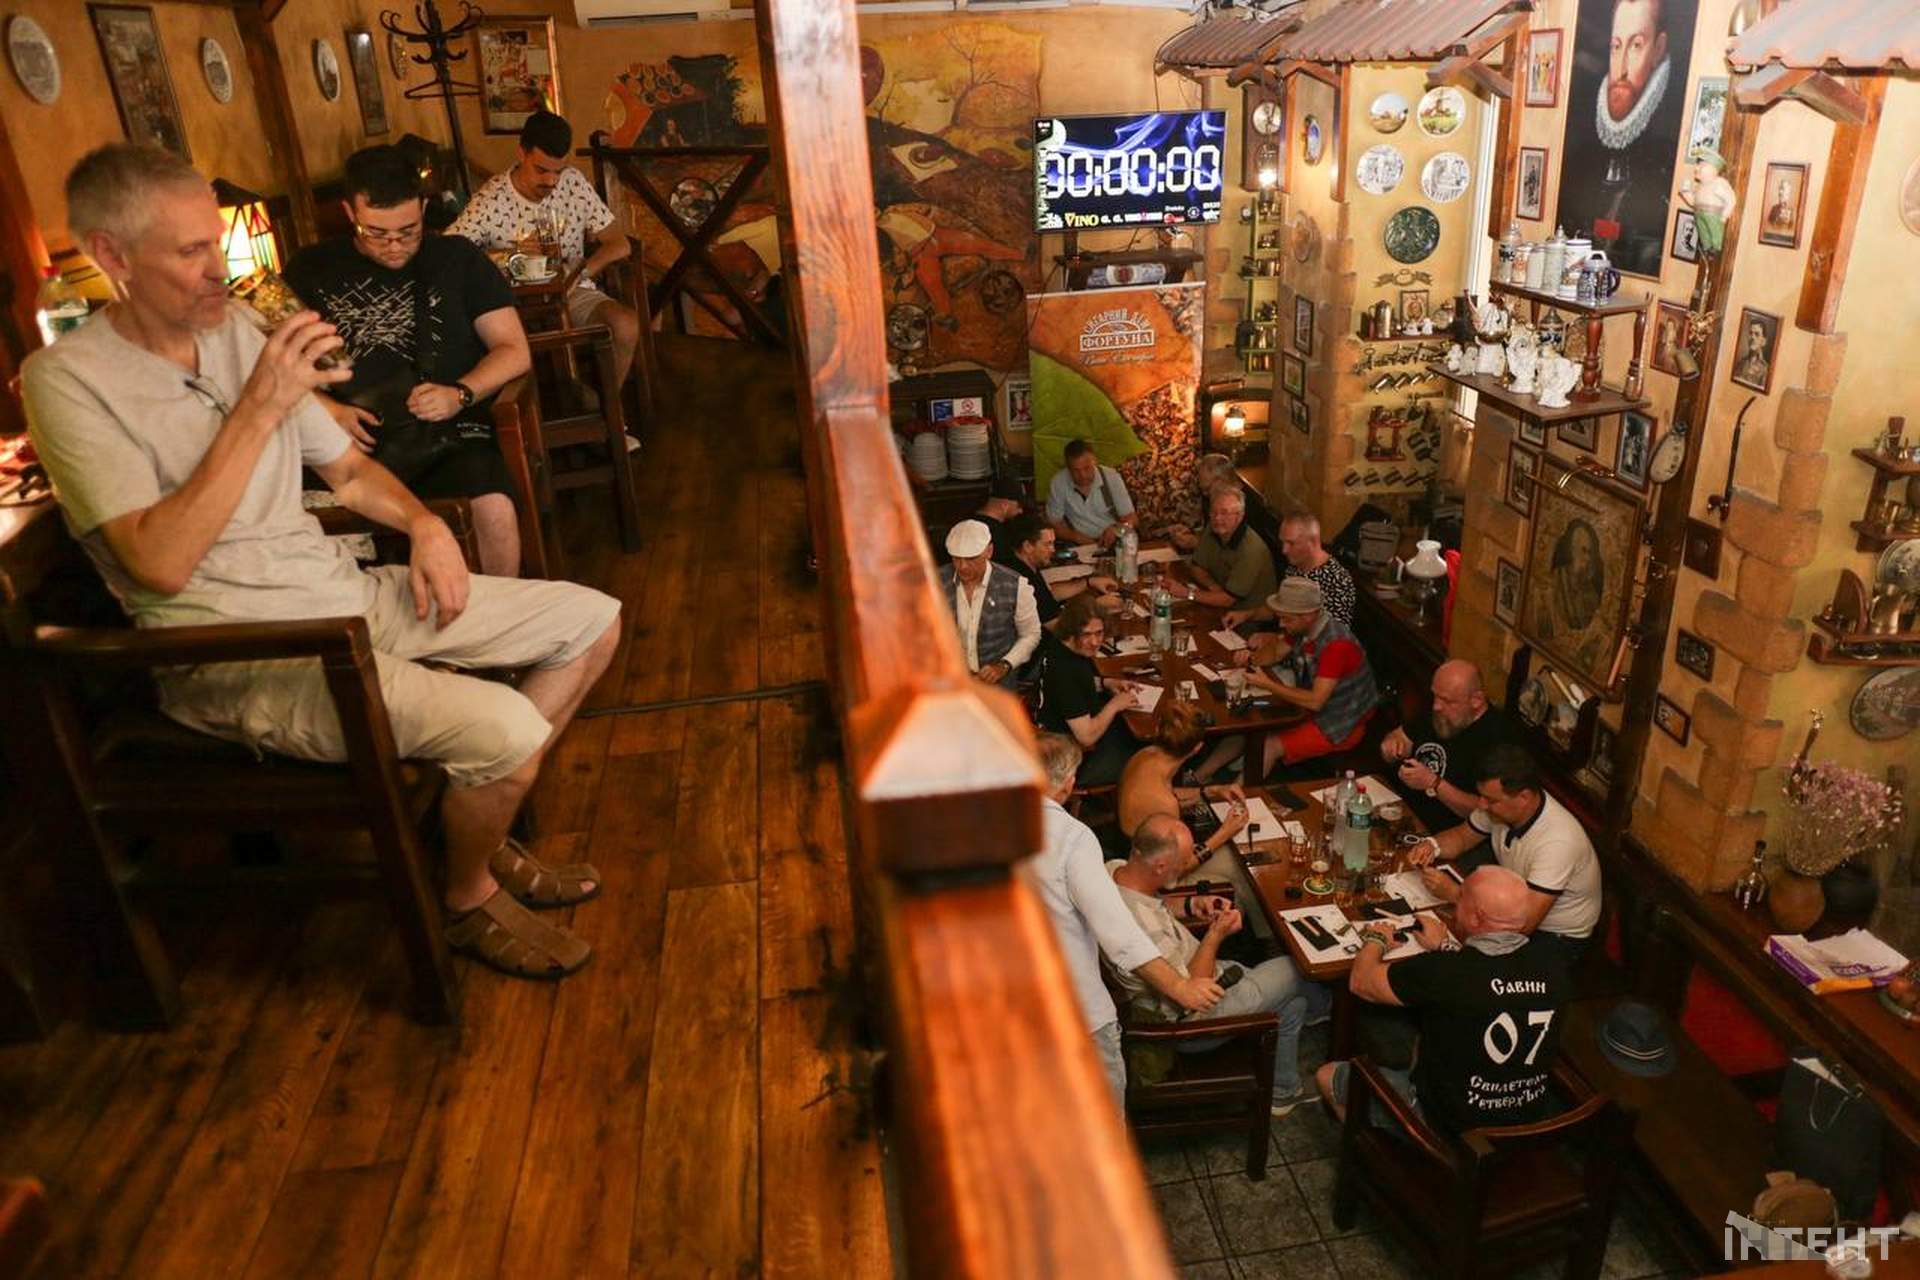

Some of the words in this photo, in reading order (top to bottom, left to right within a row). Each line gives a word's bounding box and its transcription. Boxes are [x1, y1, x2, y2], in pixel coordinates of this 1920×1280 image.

[1064, 212, 1099, 228] VINO
[1082, 332, 1151, 349] ФОРТУНА
[1483, 1010, 1555, 1065] 07
